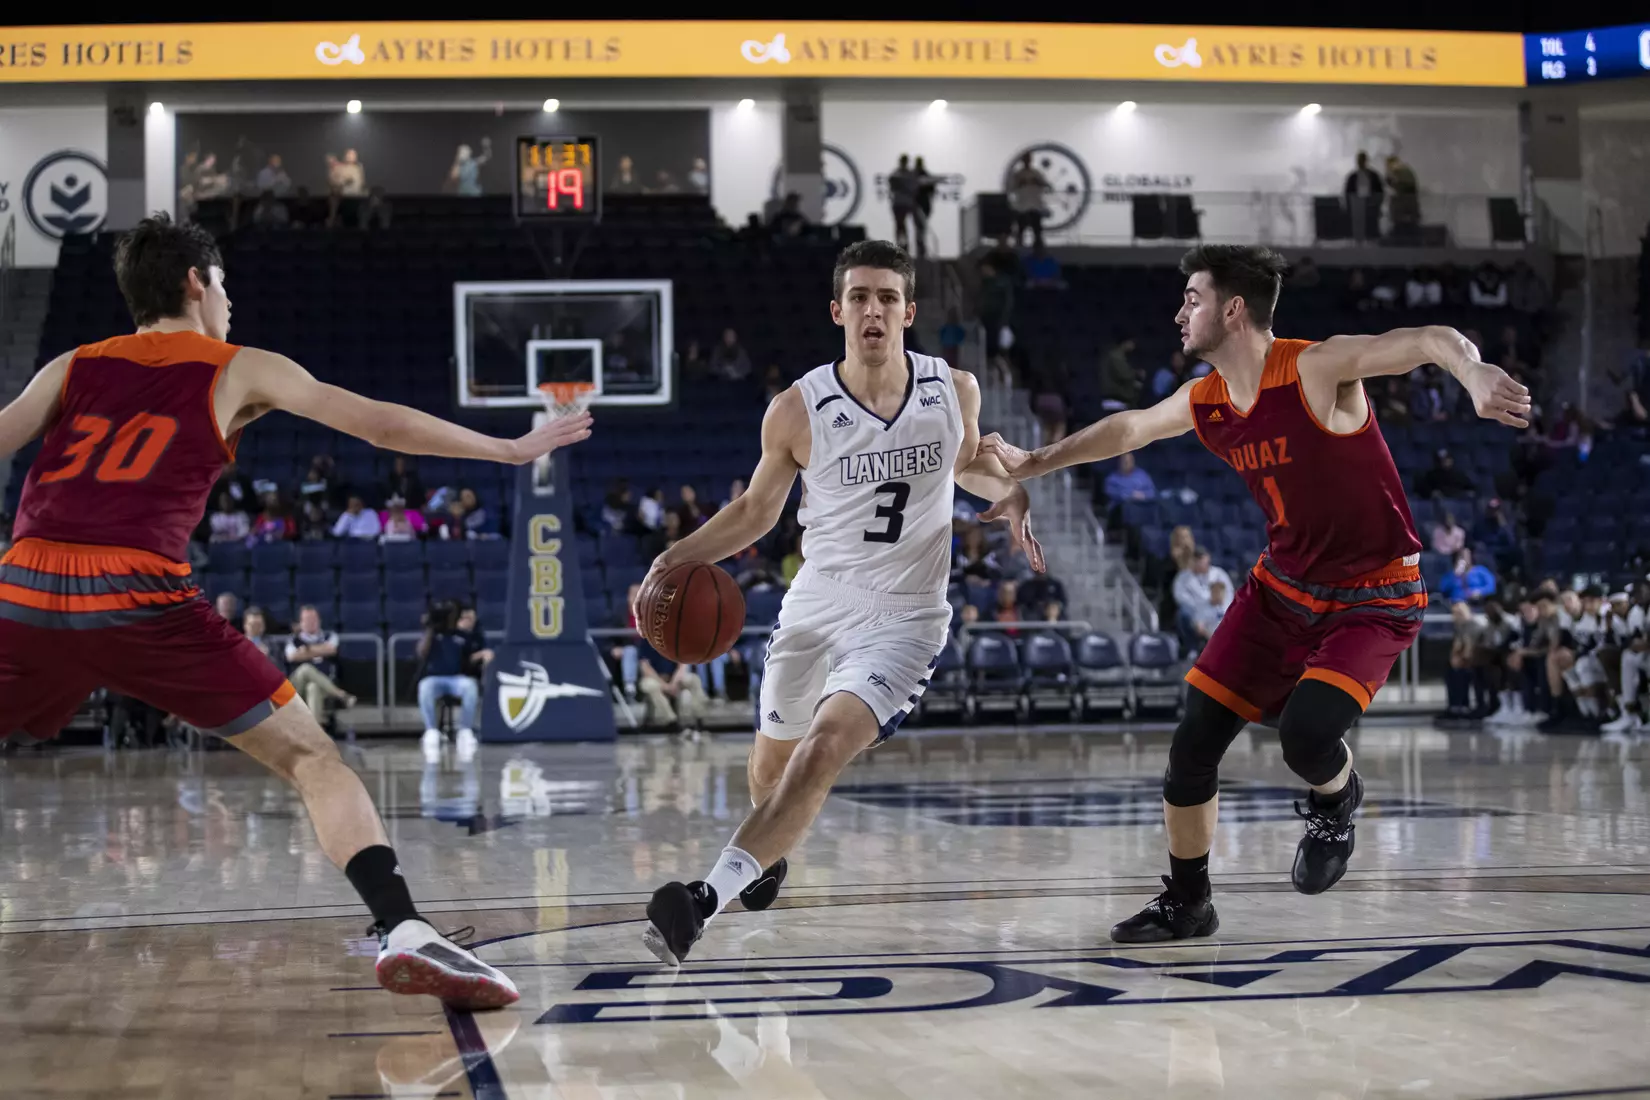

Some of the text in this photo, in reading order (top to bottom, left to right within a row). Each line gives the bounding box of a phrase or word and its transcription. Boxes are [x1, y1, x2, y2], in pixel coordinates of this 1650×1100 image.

[61, 40, 194, 66] HOTELS
[371, 36, 622, 63] AYRES HOTELS
[795, 37, 1040, 63] AYRES HOTELS
[1204, 43, 1438, 70] AYRES HOTELS
[1585, 32, 1596, 52] 4
[547, 167, 584, 210] 19
[919, 395, 941, 408] WAC
[832, 419, 854, 429] adidas
[38, 411, 178, 483] 30
[1229, 436, 1292, 472] OUAZ
[839, 441, 943, 486] LANCERS
[863, 482, 911, 543] 3
[1262, 475, 1290, 528] 1
[528, 513, 565, 640] CBU
